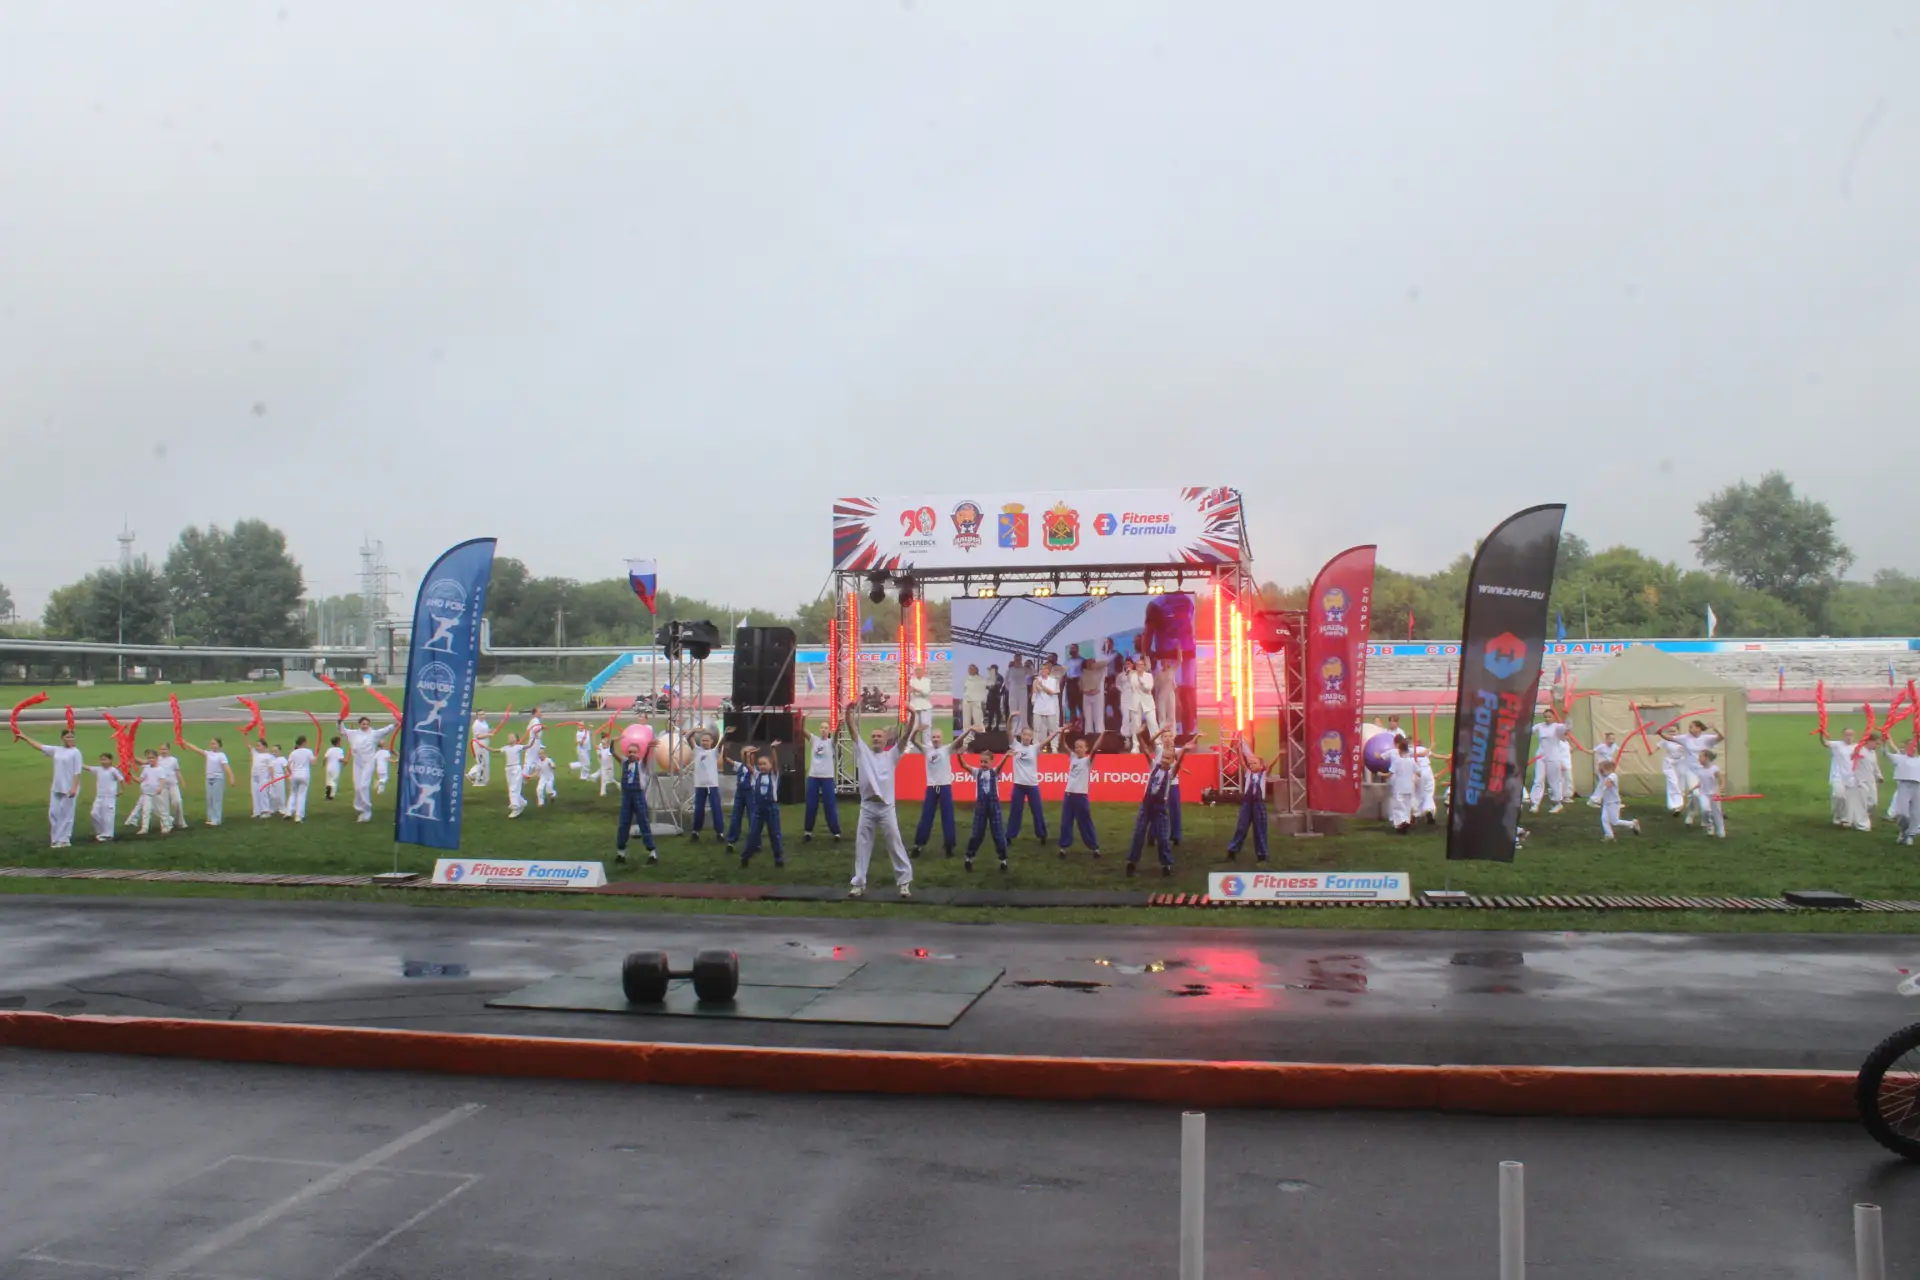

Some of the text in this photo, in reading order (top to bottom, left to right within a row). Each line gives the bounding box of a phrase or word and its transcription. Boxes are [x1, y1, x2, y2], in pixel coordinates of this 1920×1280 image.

[1122, 512, 1170, 523] Fitness
[1122, 524, 1177, 535] Formula
[1478, 584, 1545, 600] WWW.24FF.RU
[1360, 587, 1369, 631] СПОРТ
[1466, 690, 1499, 805] Formula
[1488, 691, 1522, 791] Fitness
[470, 863, 589, 879] Fitness Formula
[1253, 875, 1399, 889] Fitness Formula
